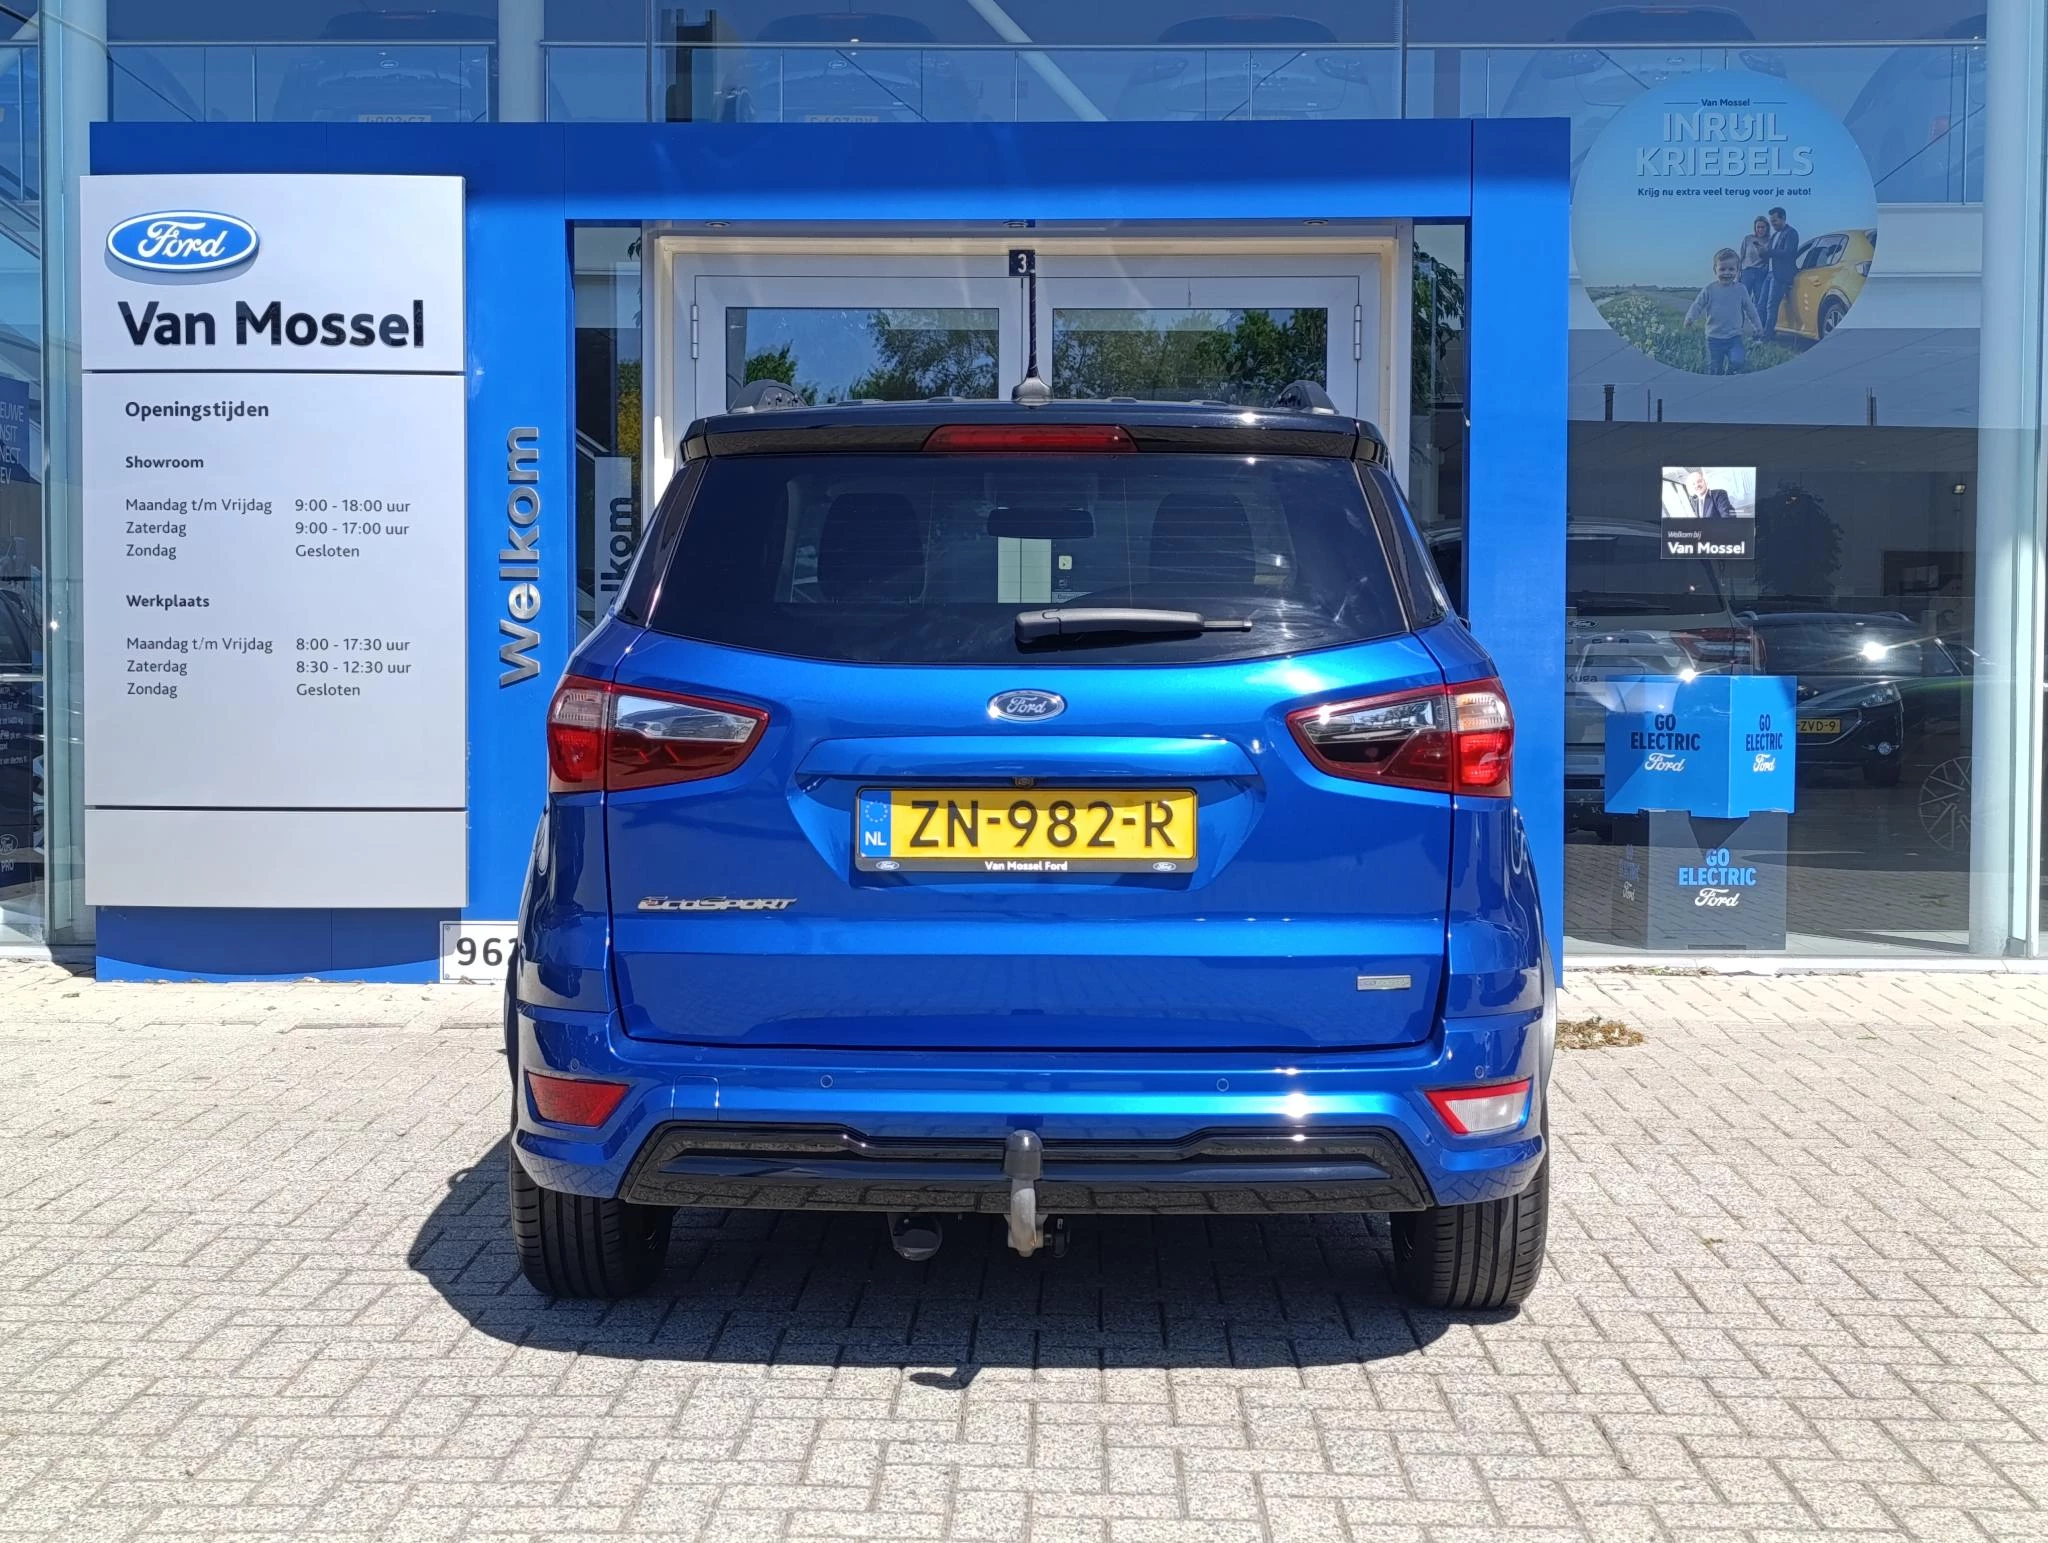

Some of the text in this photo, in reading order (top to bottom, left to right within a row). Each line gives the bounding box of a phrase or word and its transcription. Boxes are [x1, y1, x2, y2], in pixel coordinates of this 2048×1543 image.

[1701, 98, 1750, 107] Van Mossel
[1663, 112, 1788, 142] INRUIL
[1636, 146, 1814, 177] KRIEBELS
[1638, 187, 1660, 198] Krijg
[1676, 188, 1700, 196] extra
[1703, 187, 1722, 196] veel
[1725, 188, 1750, 198] terug
[1775, 188, 1784, 198] je
[1787, 187, 1812, 196] auto!
[137, 220, 229, 258] Ford
[1018, 253, 1027, 273] 3
[117, 299, 424, 348] Van Mossel
[125, 401, 269, 421] Openingstijden
[125, 456, 204, 468] Showroom
[125, 499, 187, 515] Maandag
[192, 498, 217, 512] t/m
[222, 498, 272, 515] Vrijdag
[295, 499, 327, 512] 9:00
[342, 499, 382, 512] 18:00
[386, 502, 410, 512] uur
[126, 521, 187, 537] Zaterdag
[295, 522, 327, 535] 9:00
[342, 522, 381, 535] 17:00
[385, 525, 409, 535] uur
[1693, 531, 1702, 540] bij
[126, 544, 360, 560] Zondag Gesloten
[601, 497, 633, 604] lkom
[1668, 541, 1745, 554] Van Mossel
[500, 427, 540, 687] Welkom
[126, 594, 210, 611] Werkplaats
[126, 637, 188, 653] Maandag
[192, 636, 218, 650] t/m
[222, 637, 273, 654] Vrijdag
[296, 638, 329, 651] 8:00
[343, 638, 382, 651] 17:30
[386, 641, 410, 651] uur
[126, 660, 187, 676] Zaterdag
[296, 661, 329, 674] 8:30
[343, 661, 383, 674] 12:30
[387, 664, 412, 674] uur
[127, 682, 361, 699] Zondag Gesloten
[1006, 697, 1046, 715] Ford
[1655, 714, 1676, 731] GO
[1759, 714, 1770, 731] GO
[1631, 732, 1701, 750] ELECTRIC
[1746, 733, 1783, 751] ELECTRIC
[1644, 753, 1687, 772] Ford
[1753, 753, 1775, 772] Ford
[909, 799, 1176, 849] ZN-982-R
[865, 831, 887, 847] NL
[985, 860, 1067, 870] Van Mossel Ford
[1706, 848, 1730, 866] GO
[1678, 867, 1757, 886] ELECTRIC
[1694, 887, 1740, 907] Ford
